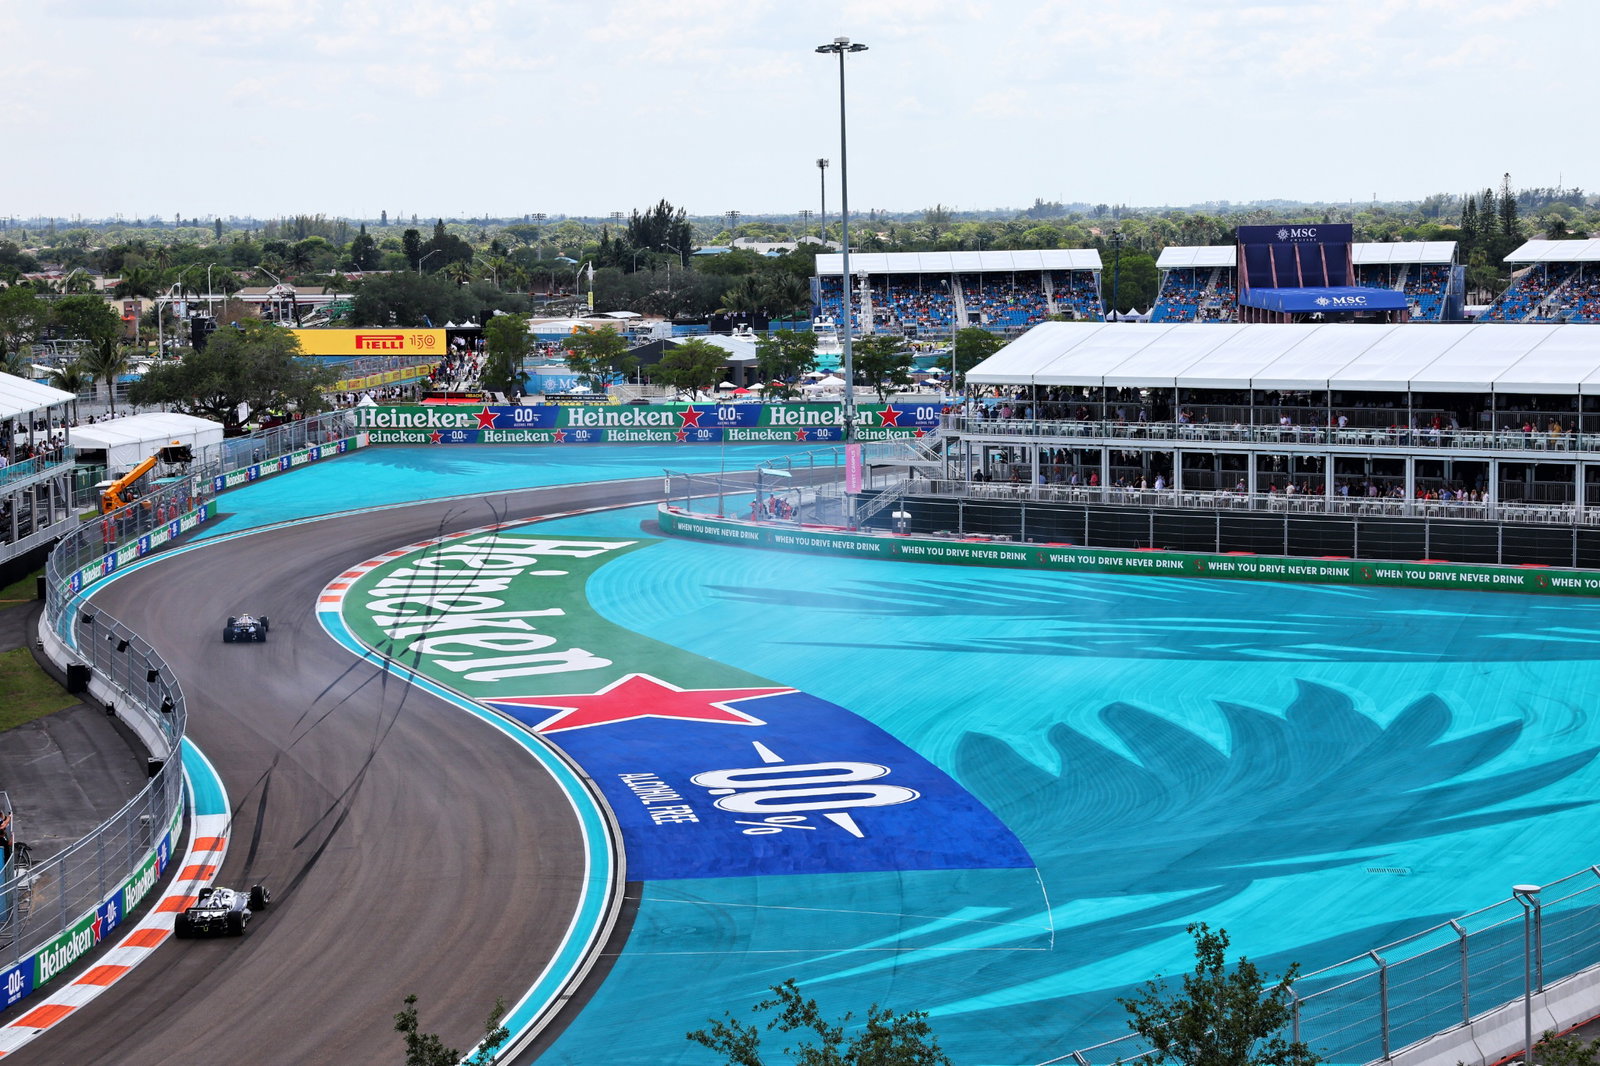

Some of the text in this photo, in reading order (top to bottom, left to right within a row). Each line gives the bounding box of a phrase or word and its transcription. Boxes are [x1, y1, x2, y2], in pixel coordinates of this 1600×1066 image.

[1290, 228, 1316, 237] MSC
[356, 335, 404, 349] PIRELLI
[360, 408, 470, 428] Heineken
[568, 408, 674, 426] Heineken
[770, 406, 873, 425] Heinekn
[484, 430, 549, 442] Heineken
[608, 430, 671, 441] Heineken
[729, 429, 792, 440] Heineken
[678, 522, 692, 531] WHEN
[705, 527, 720, 535] DRIVE
[721, 529, 739, 537] NEVER
[741, 531, 759, 540] DRINK
[775, 535, 880, 551] WHEN YOU DRIVE NEVER DRINK
[901, 545, 1026, 560] WHEN YOU DRIVE NEVER DRINK
[1050, 554, 1184, 568] WHEN YOU DRIVE NEVER DRINK
[1208, 562, 1350, 576] WHEN YOU DRIVE NEVER DRINK
[1375, 569, 1524, 584] WHEN YOU DRIVE NEVER DRINK
[1552, 578, 1581, 587] WHEN
[366, 536, 639, 682] Heineken
[618, 773, 700, 826] ALCOHOL FREE
[125, 864, 155, 914] Heineken
[40, 927, 91, 984] Heineken
